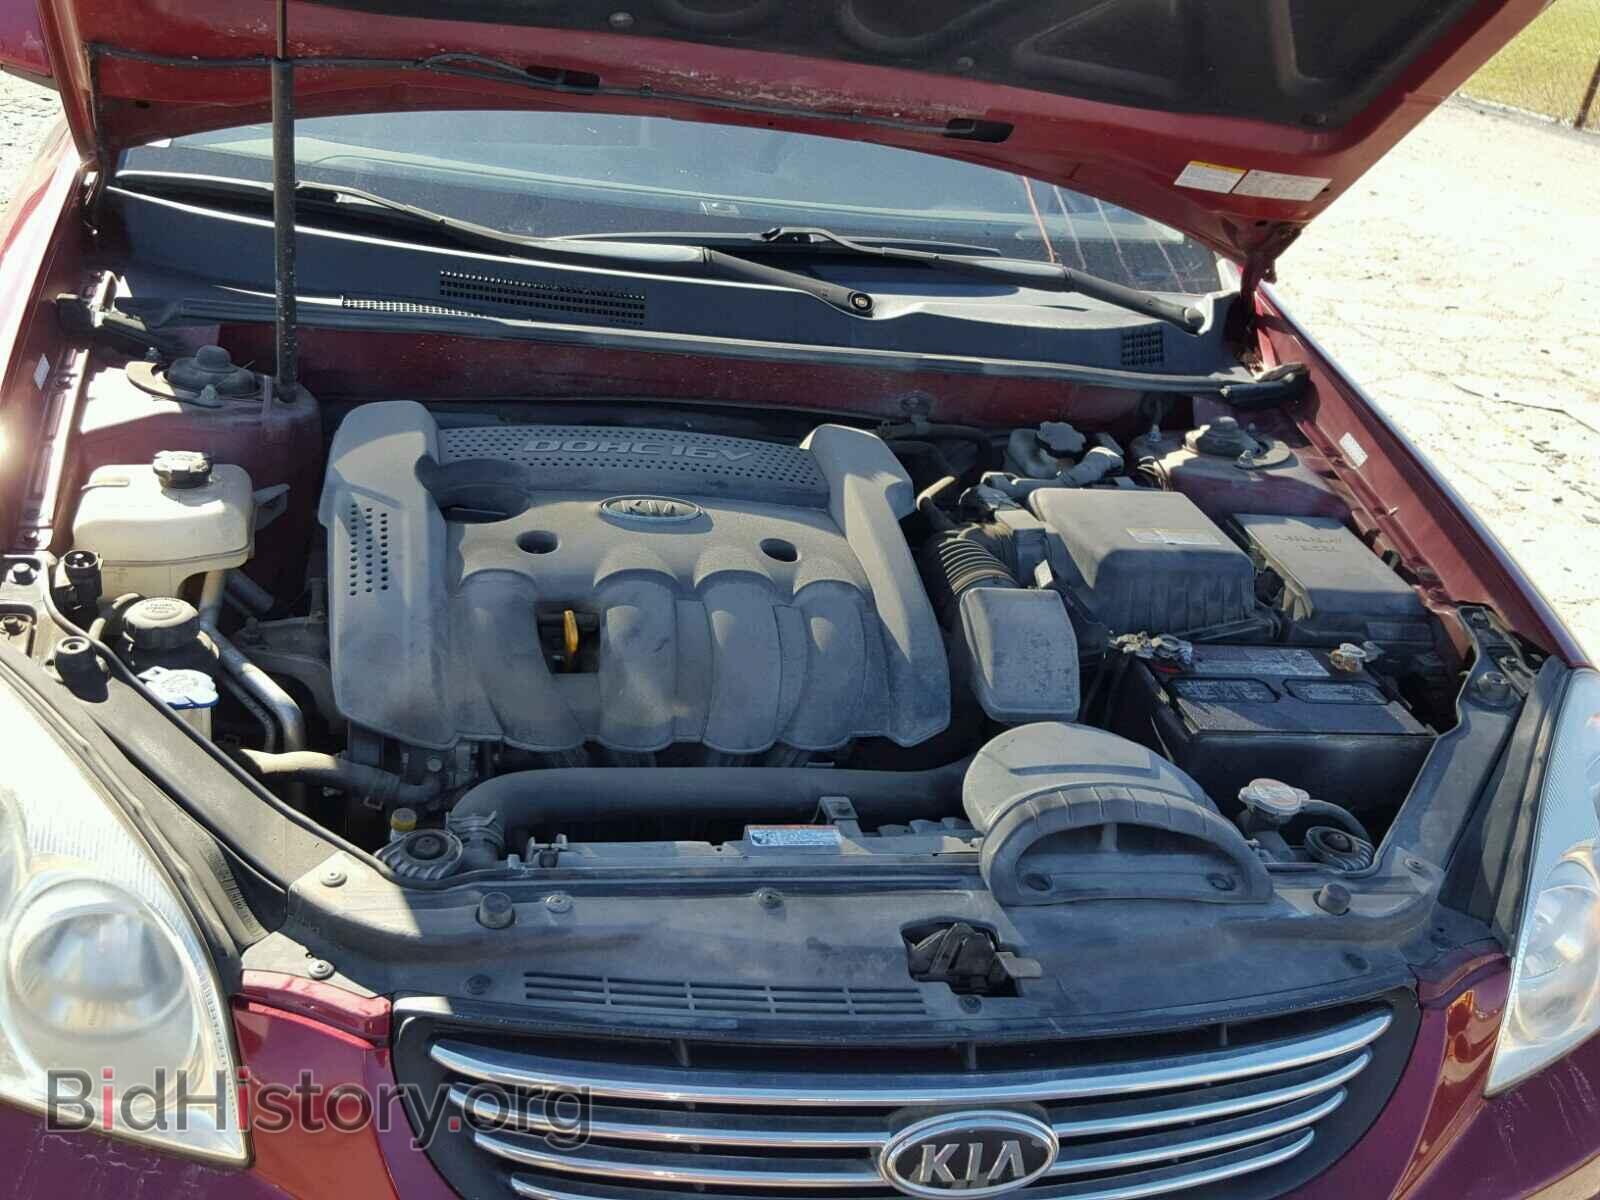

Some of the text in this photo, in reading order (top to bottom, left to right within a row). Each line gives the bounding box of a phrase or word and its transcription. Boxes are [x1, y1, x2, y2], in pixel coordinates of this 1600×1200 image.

[523, 439, 751, 461] DOHC 16V
[619, 499, 677, 517] KIA
[919, 1139, 1026, 1183] KIA
